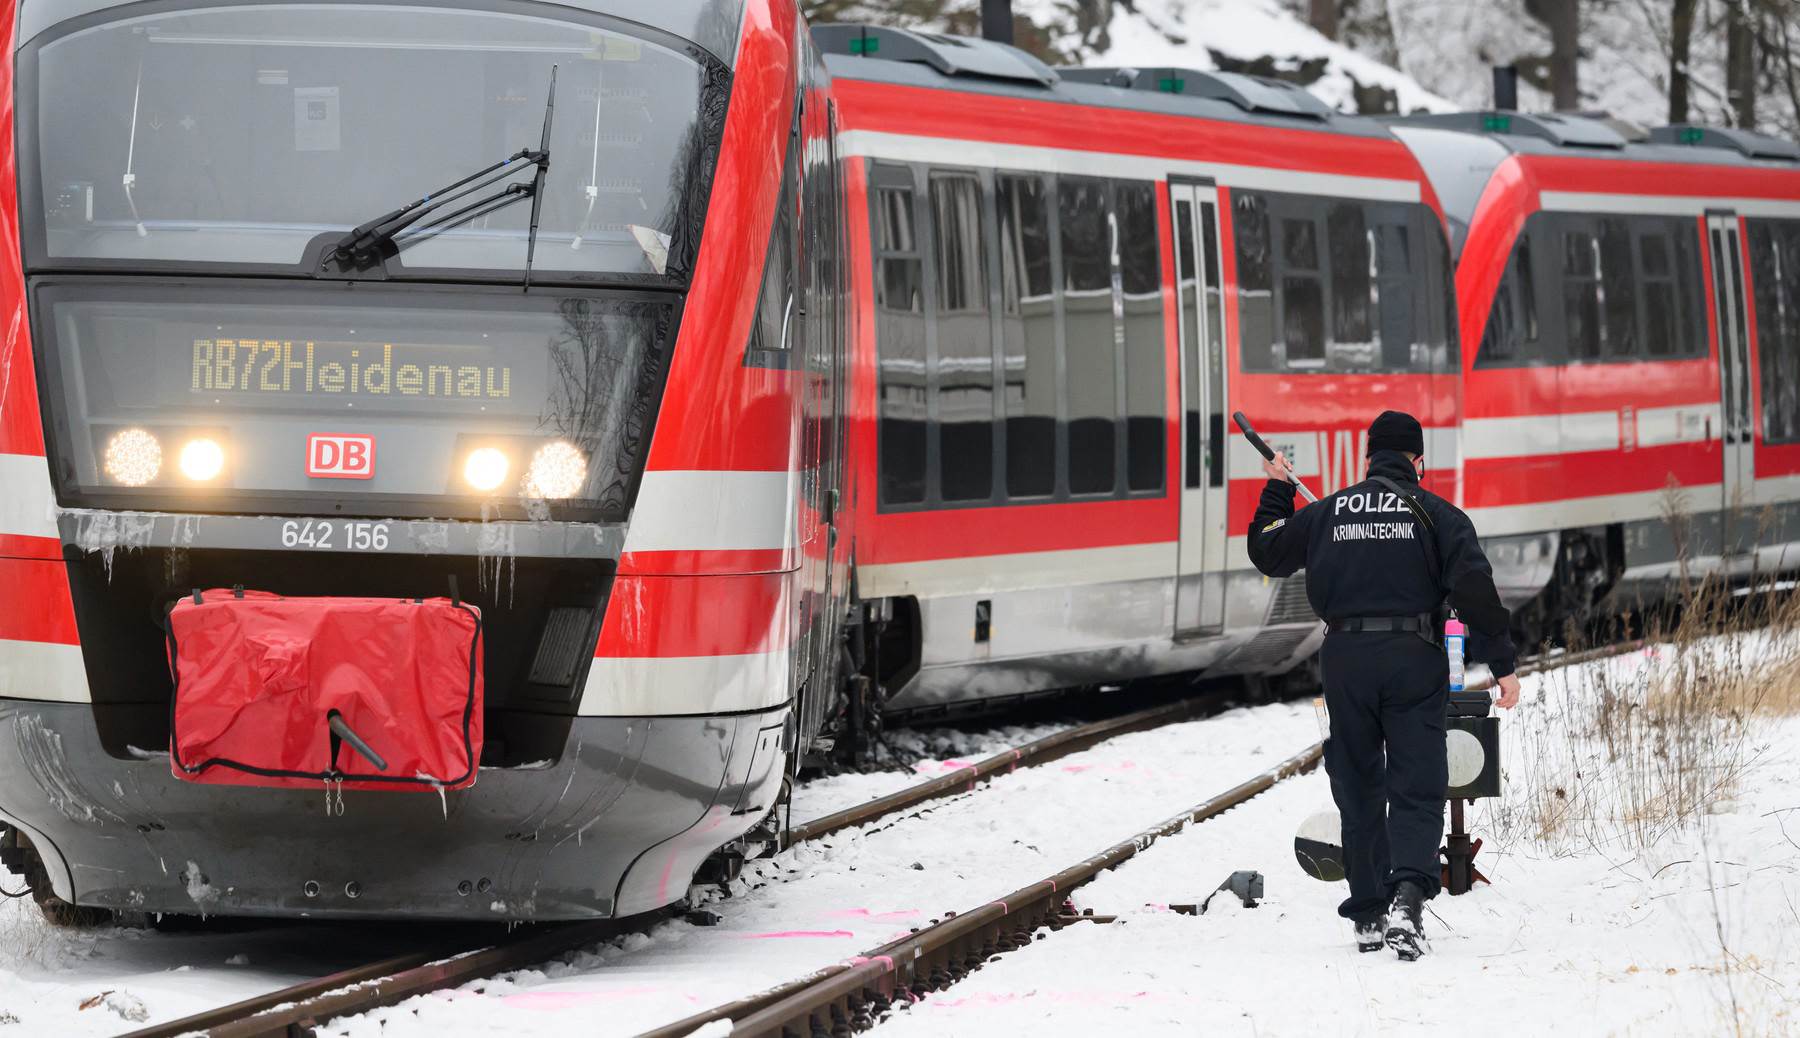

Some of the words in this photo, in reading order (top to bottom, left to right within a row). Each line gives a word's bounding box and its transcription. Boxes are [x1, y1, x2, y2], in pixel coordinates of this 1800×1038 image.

[314, 439, 368, 470] DB
[1335, 493, 1416, 516] POLIZE
[281, 520, 332, 548] 642
[344, 522, 389, 549] 156
[1333, 522, 1415, 542] KRIMINALTECHNIK
